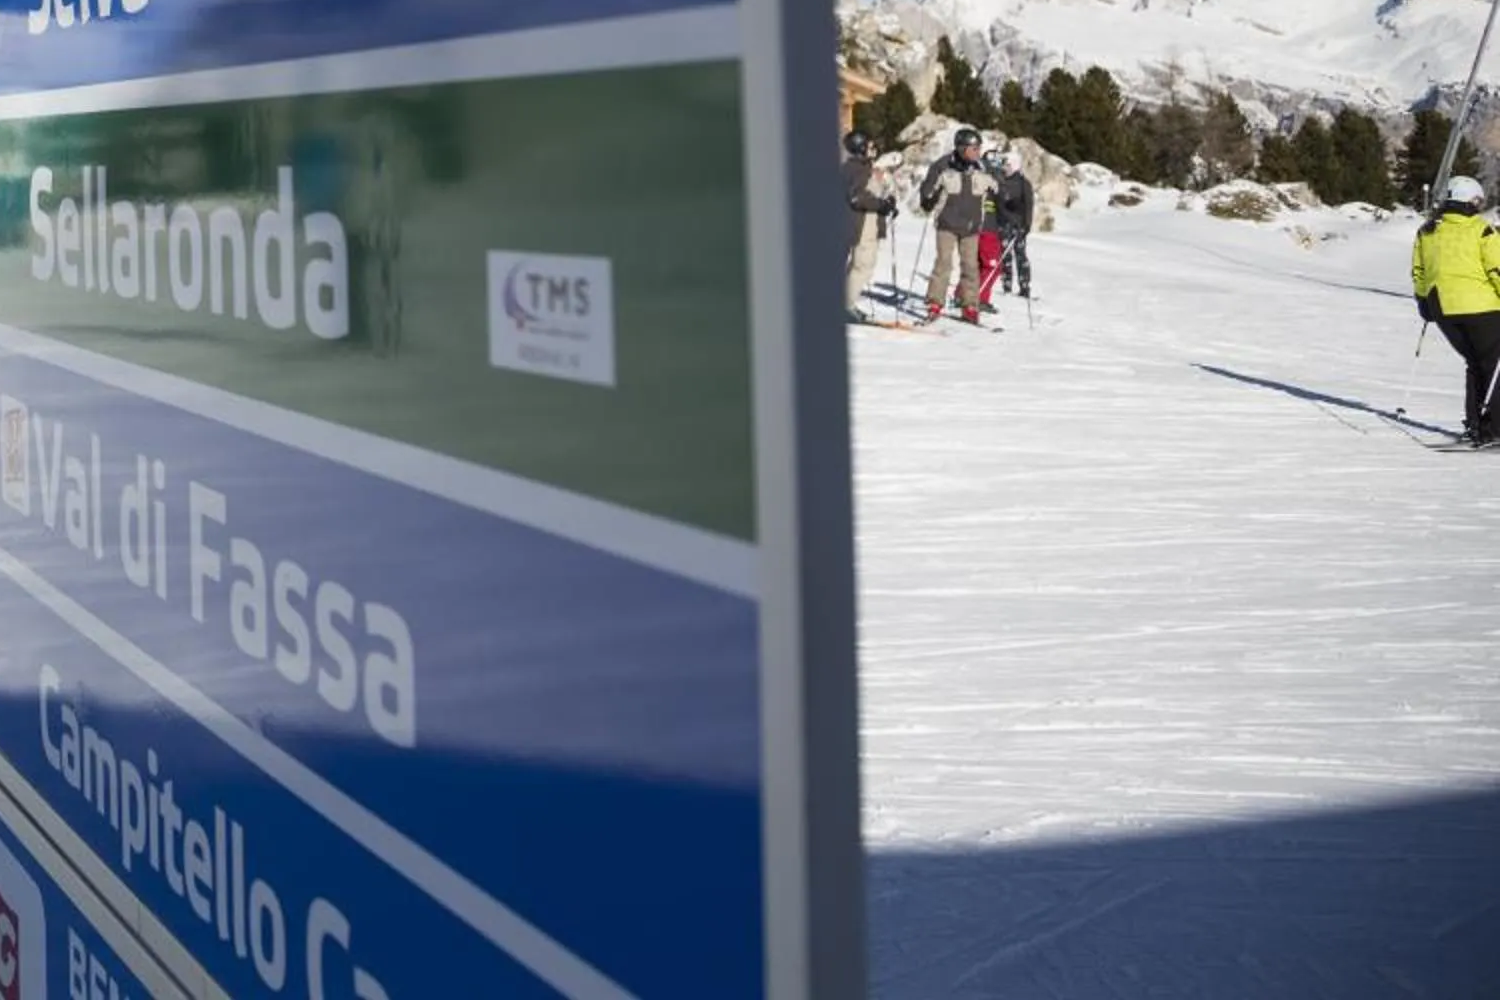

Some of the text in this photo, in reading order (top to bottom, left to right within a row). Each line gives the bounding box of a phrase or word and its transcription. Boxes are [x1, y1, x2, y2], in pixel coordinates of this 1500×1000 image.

[29, 165, 350, 339] Sellaronda
[526, 271, 590, 317] TMS
[33, 411, 416, 749] Val di Fassa
[39, 663, 392, 1000] Campitello C
